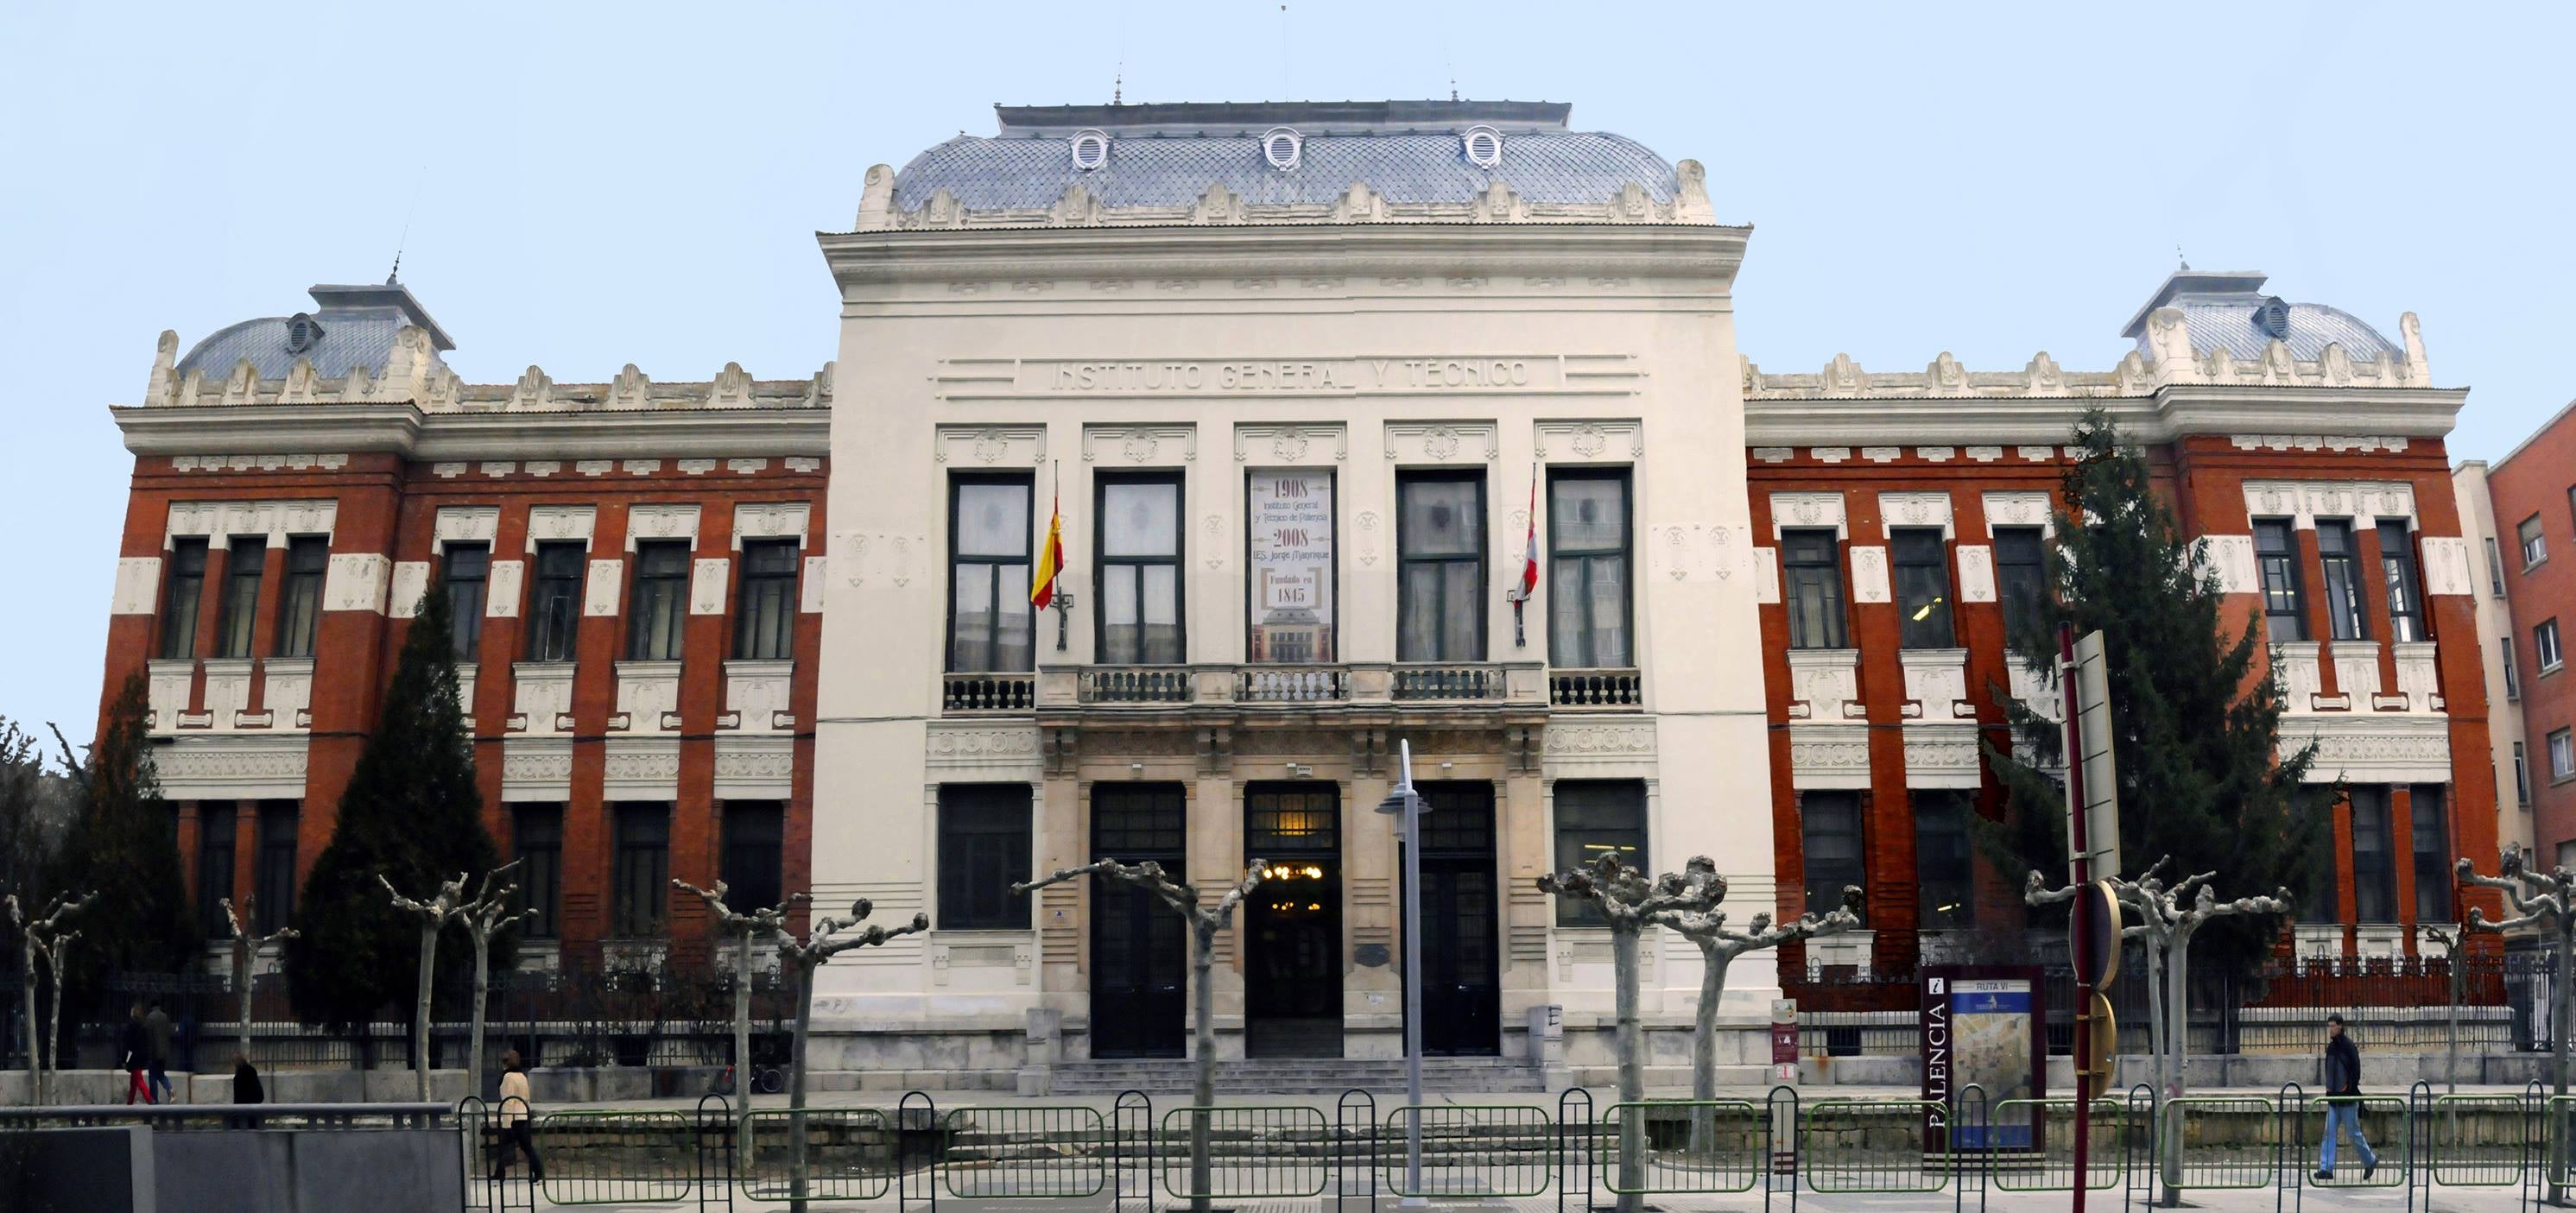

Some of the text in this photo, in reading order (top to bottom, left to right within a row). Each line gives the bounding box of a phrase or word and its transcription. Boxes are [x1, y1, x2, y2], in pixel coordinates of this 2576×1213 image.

[1051, 363, 1203, 389] INSTITUTO
[1219, 361, 1356, 389] GENERAL
[1371, 360, 1389, 387] Y
[1275, 479, 1308, 498] 1908
[1263, 501, 1319, 511] Instituto General
[1289, 513, 1298, 521] de
[1299, 513, 1327, 523] Palencia
[1273, 528, 1308, 547] 2008
[1270, 551, 1291, 562] Jorge
[1292, 550, 1329, 561] Manrique
[1270, 575, 1301, 584] Fundado
[1278, 588, 1305, 603] 1845
[1976, 982, 1998, 991] RUTA
[1928, 1002, 1946, 1128] PALENCIA
